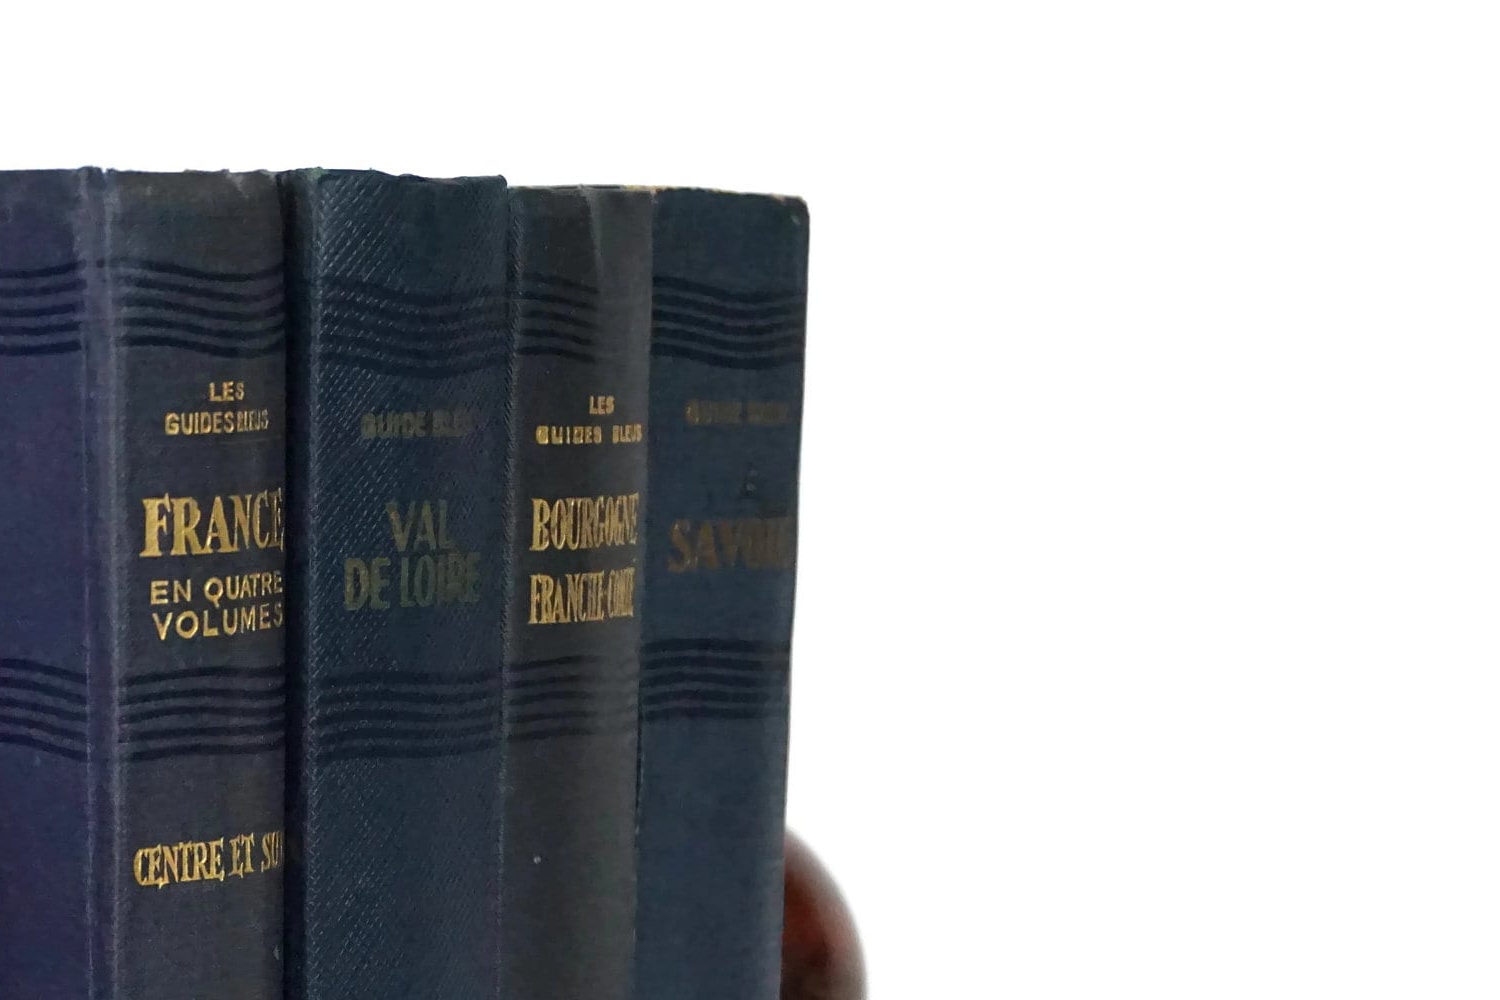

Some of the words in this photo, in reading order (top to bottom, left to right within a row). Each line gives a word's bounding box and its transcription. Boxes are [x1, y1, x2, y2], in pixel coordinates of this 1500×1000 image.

[208, 381, 245, 402] LES
[588, 395, 615, 415] LES
[164, 410, 235, 436] GUIDES
[139, 487, 285, 557] FRANCE
[385, 499, 453, 551] VAL
[529, 493, 640, 551] BOURGOGNE
[150, 580, 192, 605] EN
[203, 570, 283, 608] QUATRE
[343, 555, 391, 611] DE
[152, 603, 284, 641] VOLUMES
[132, 836, 226, 889] CENTRE
[227, 831, 256, 878] ET
